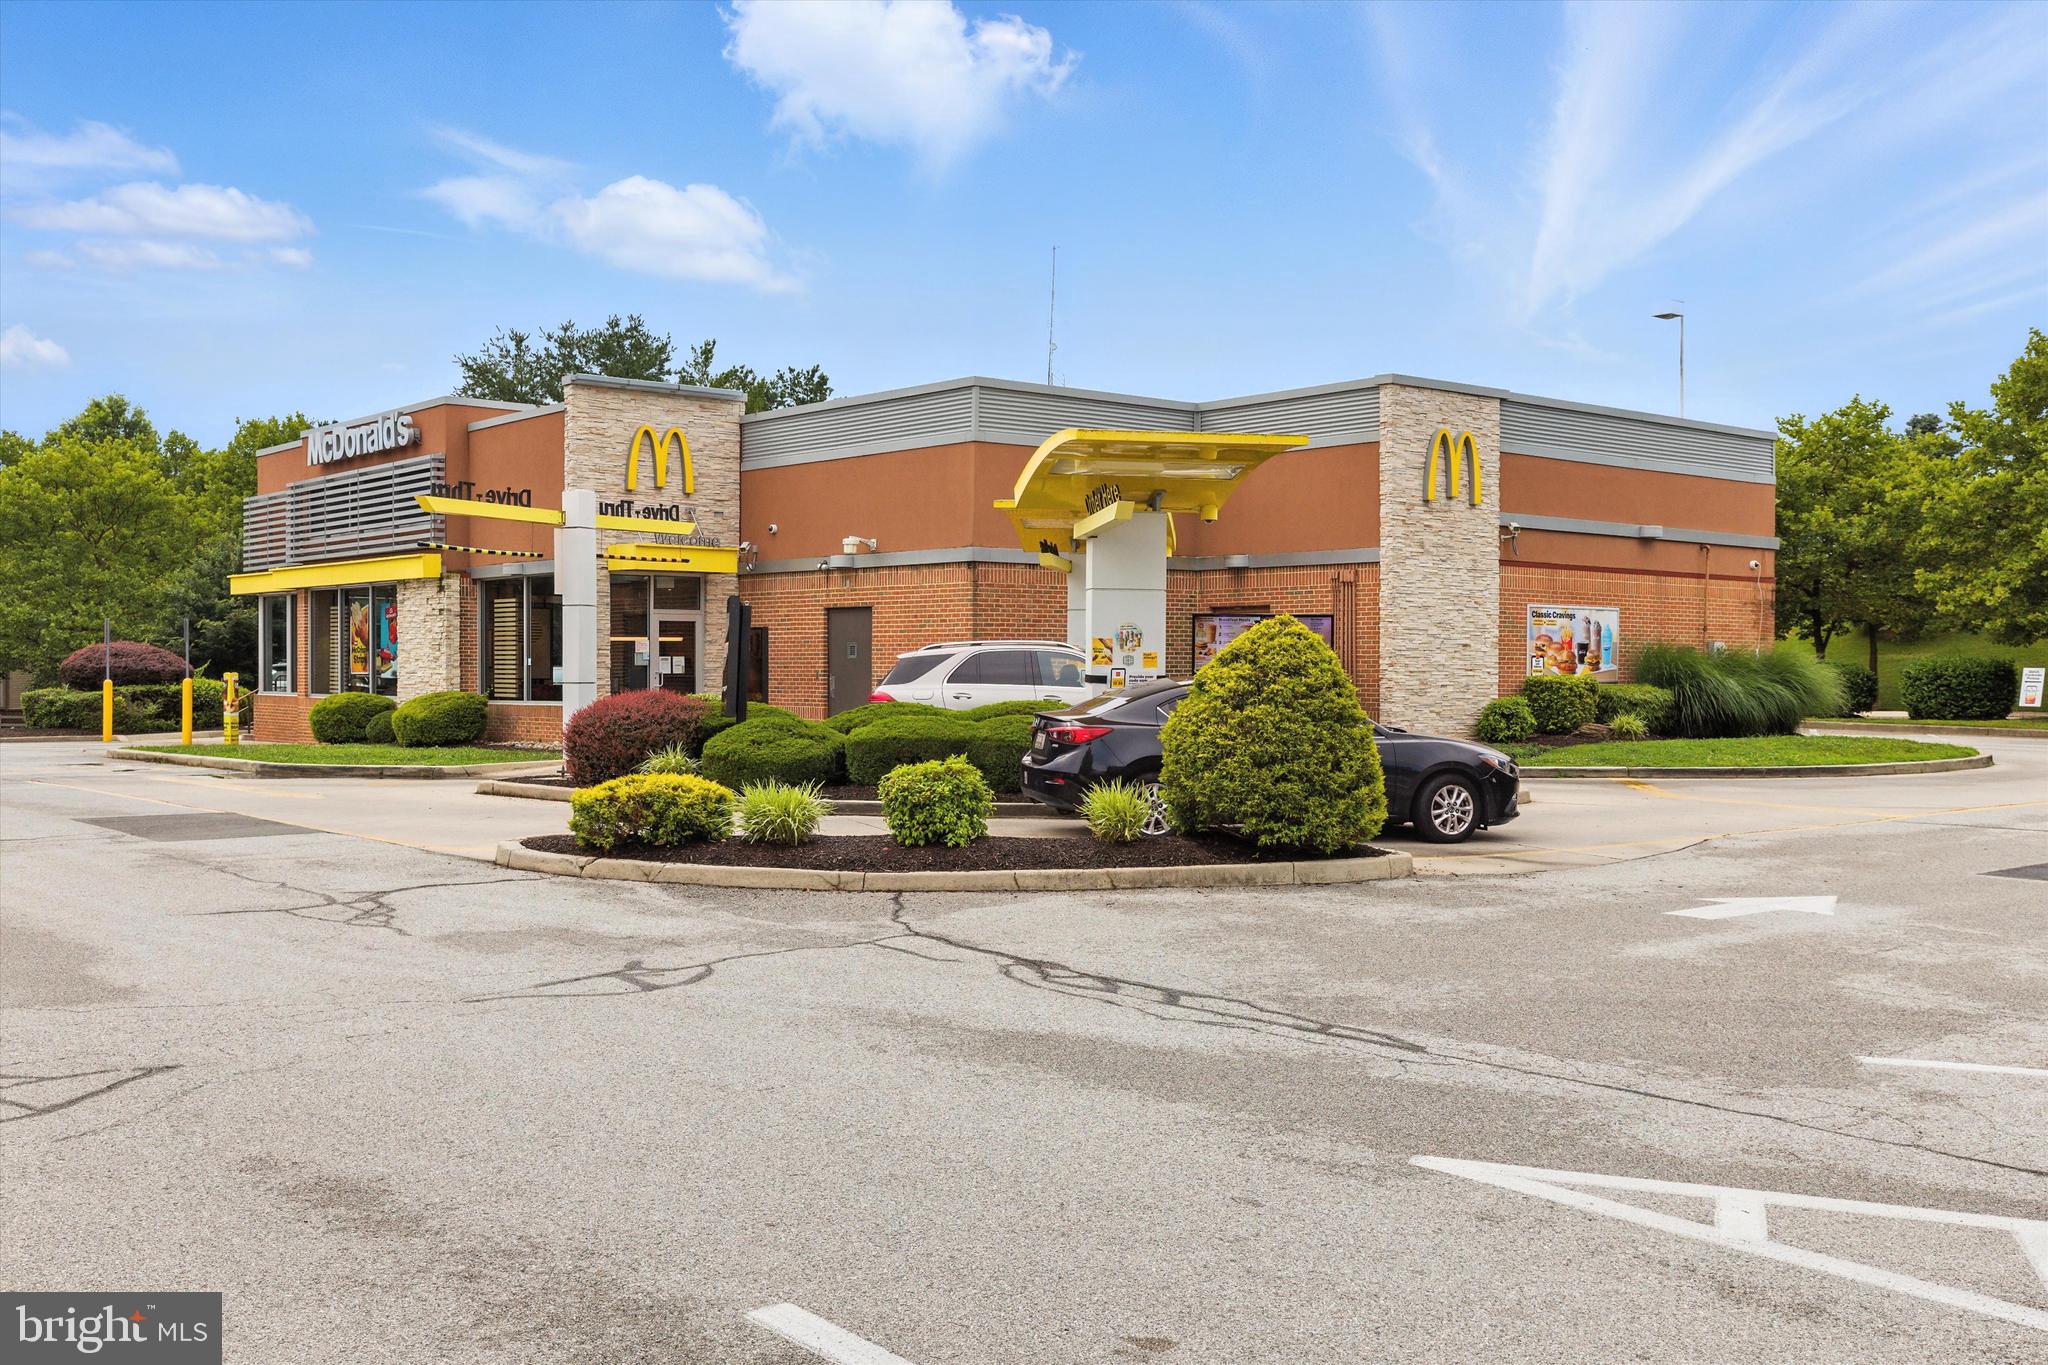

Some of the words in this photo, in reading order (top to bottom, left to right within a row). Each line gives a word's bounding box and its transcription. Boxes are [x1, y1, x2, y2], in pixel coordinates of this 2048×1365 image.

[307, 412, 414, 466] McDonald's
[1532, 610, 1552, 619] Classic
[1552, 611, 1576, 621] Cravings
